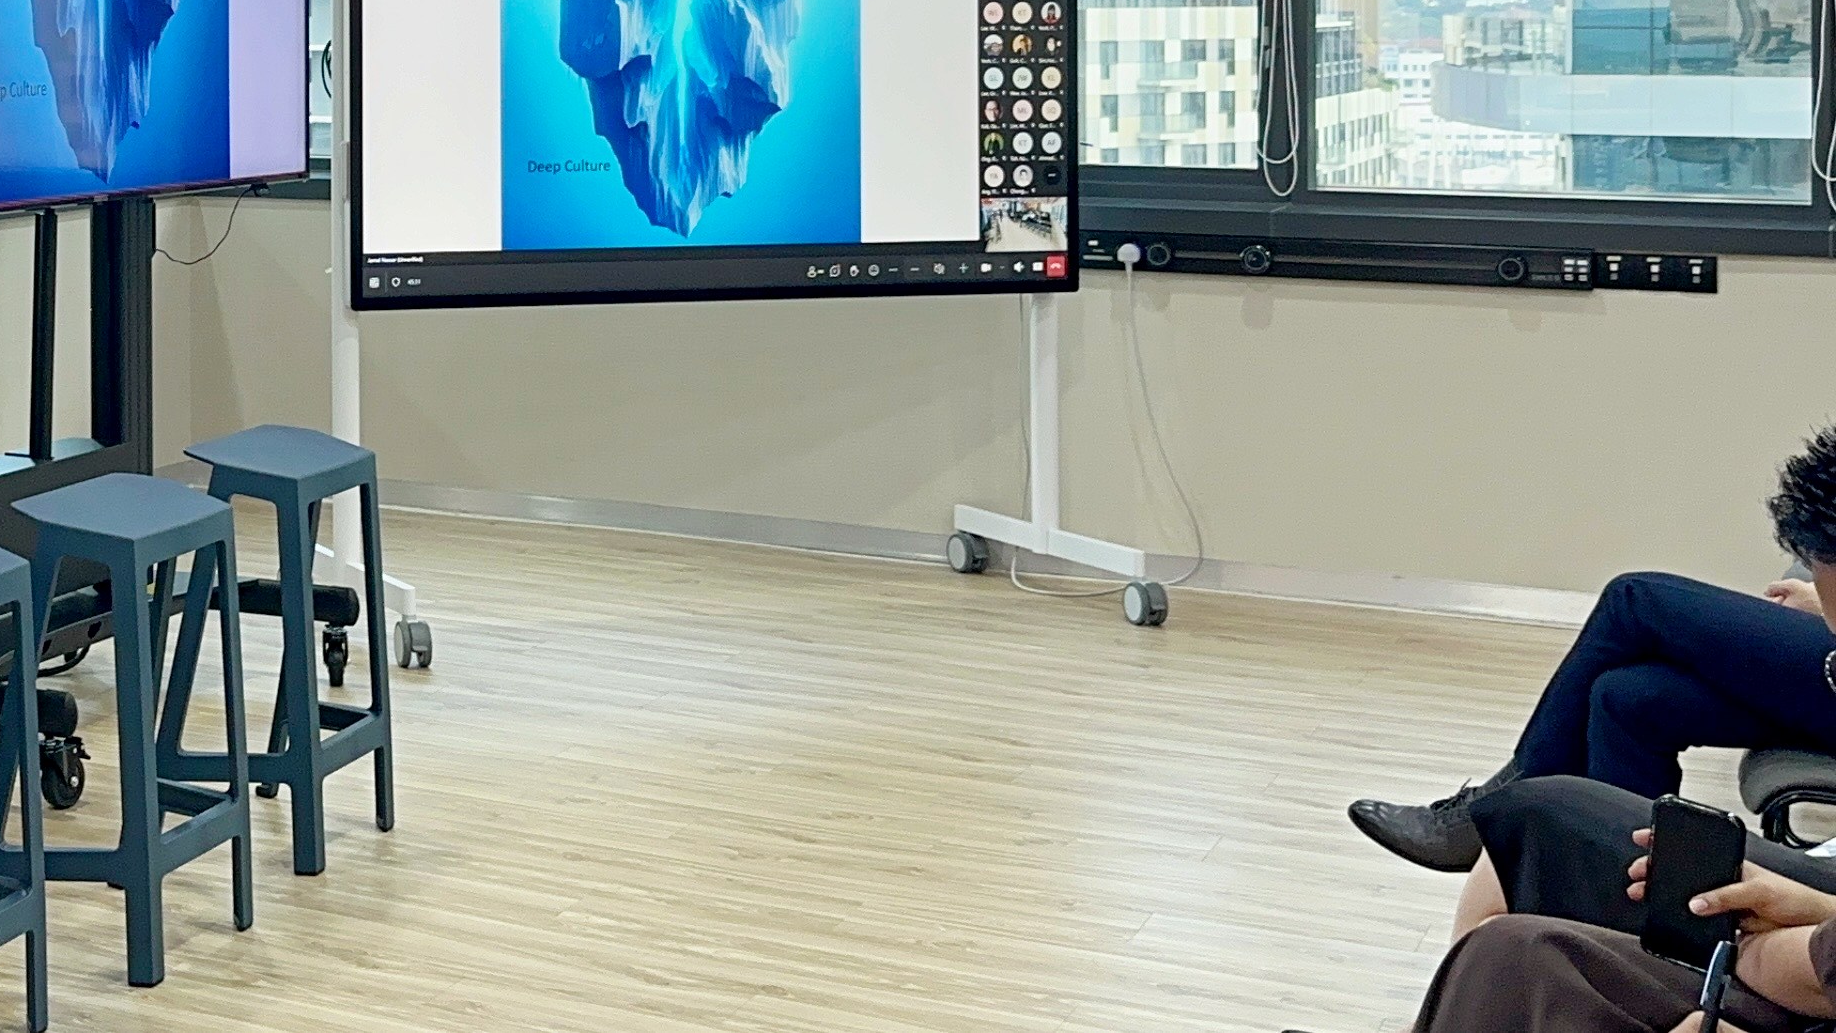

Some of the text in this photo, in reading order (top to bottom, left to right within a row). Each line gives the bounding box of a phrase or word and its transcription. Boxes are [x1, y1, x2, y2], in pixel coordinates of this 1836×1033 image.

[9, 80, 48, 98] Culture
[527, 159, 611, 175] Deep Culture
